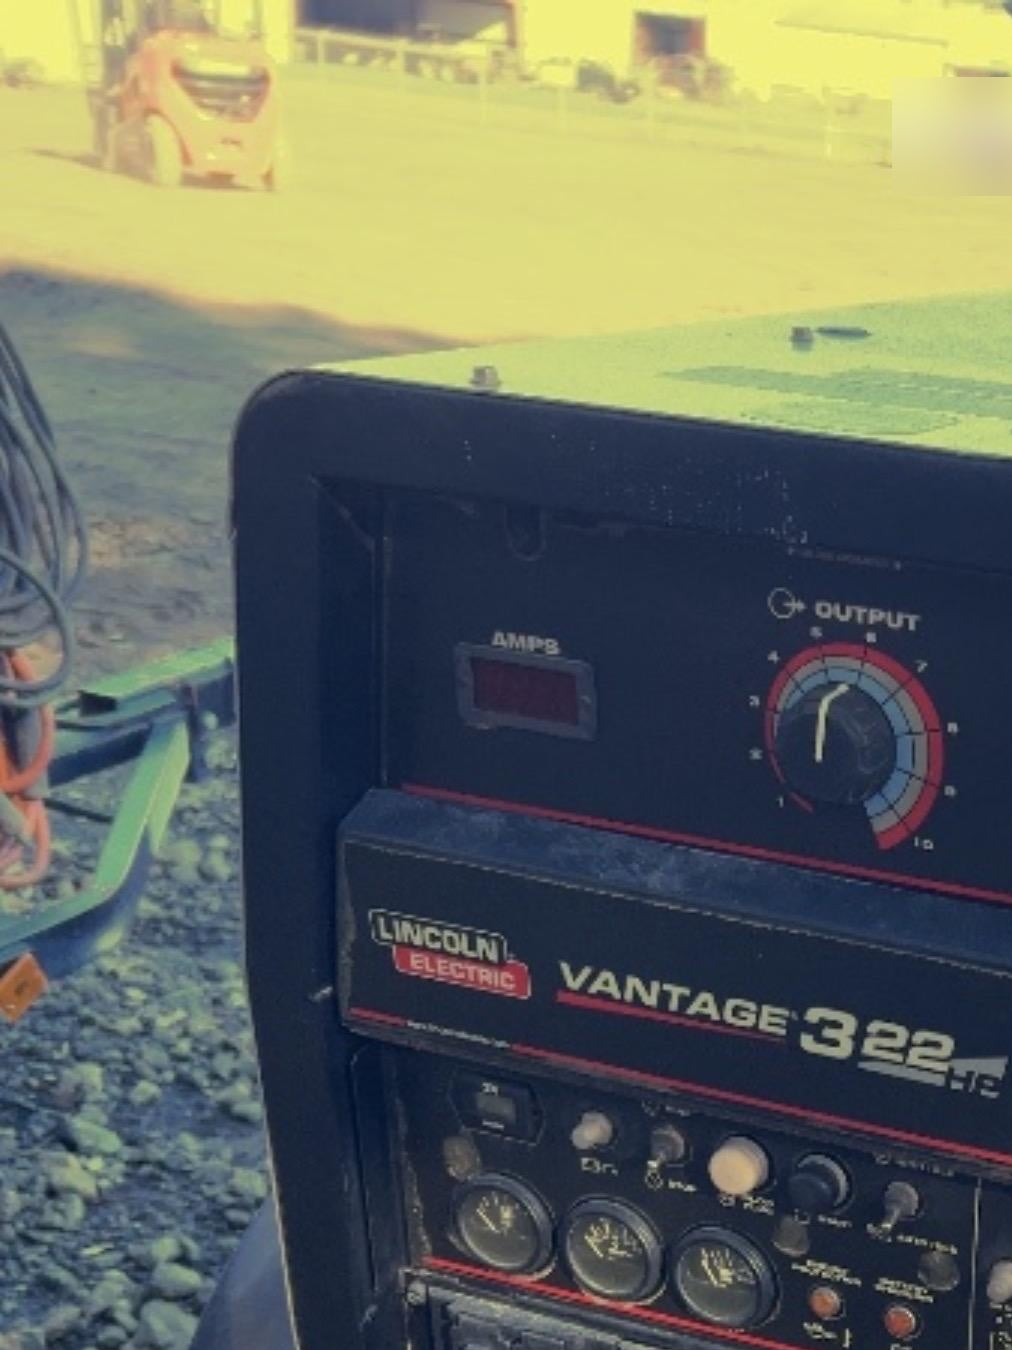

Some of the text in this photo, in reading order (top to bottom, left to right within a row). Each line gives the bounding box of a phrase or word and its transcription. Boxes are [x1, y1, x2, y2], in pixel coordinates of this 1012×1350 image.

[815, 600, 921, 631] OUTPUT
[491, 630, 560, 655] AMPS
[377, 916, 499, 963] LINCOLN
[409, 953, 517, 990] ELECTRIC
[558, 960, 956, 1073] VANTAGE 322
